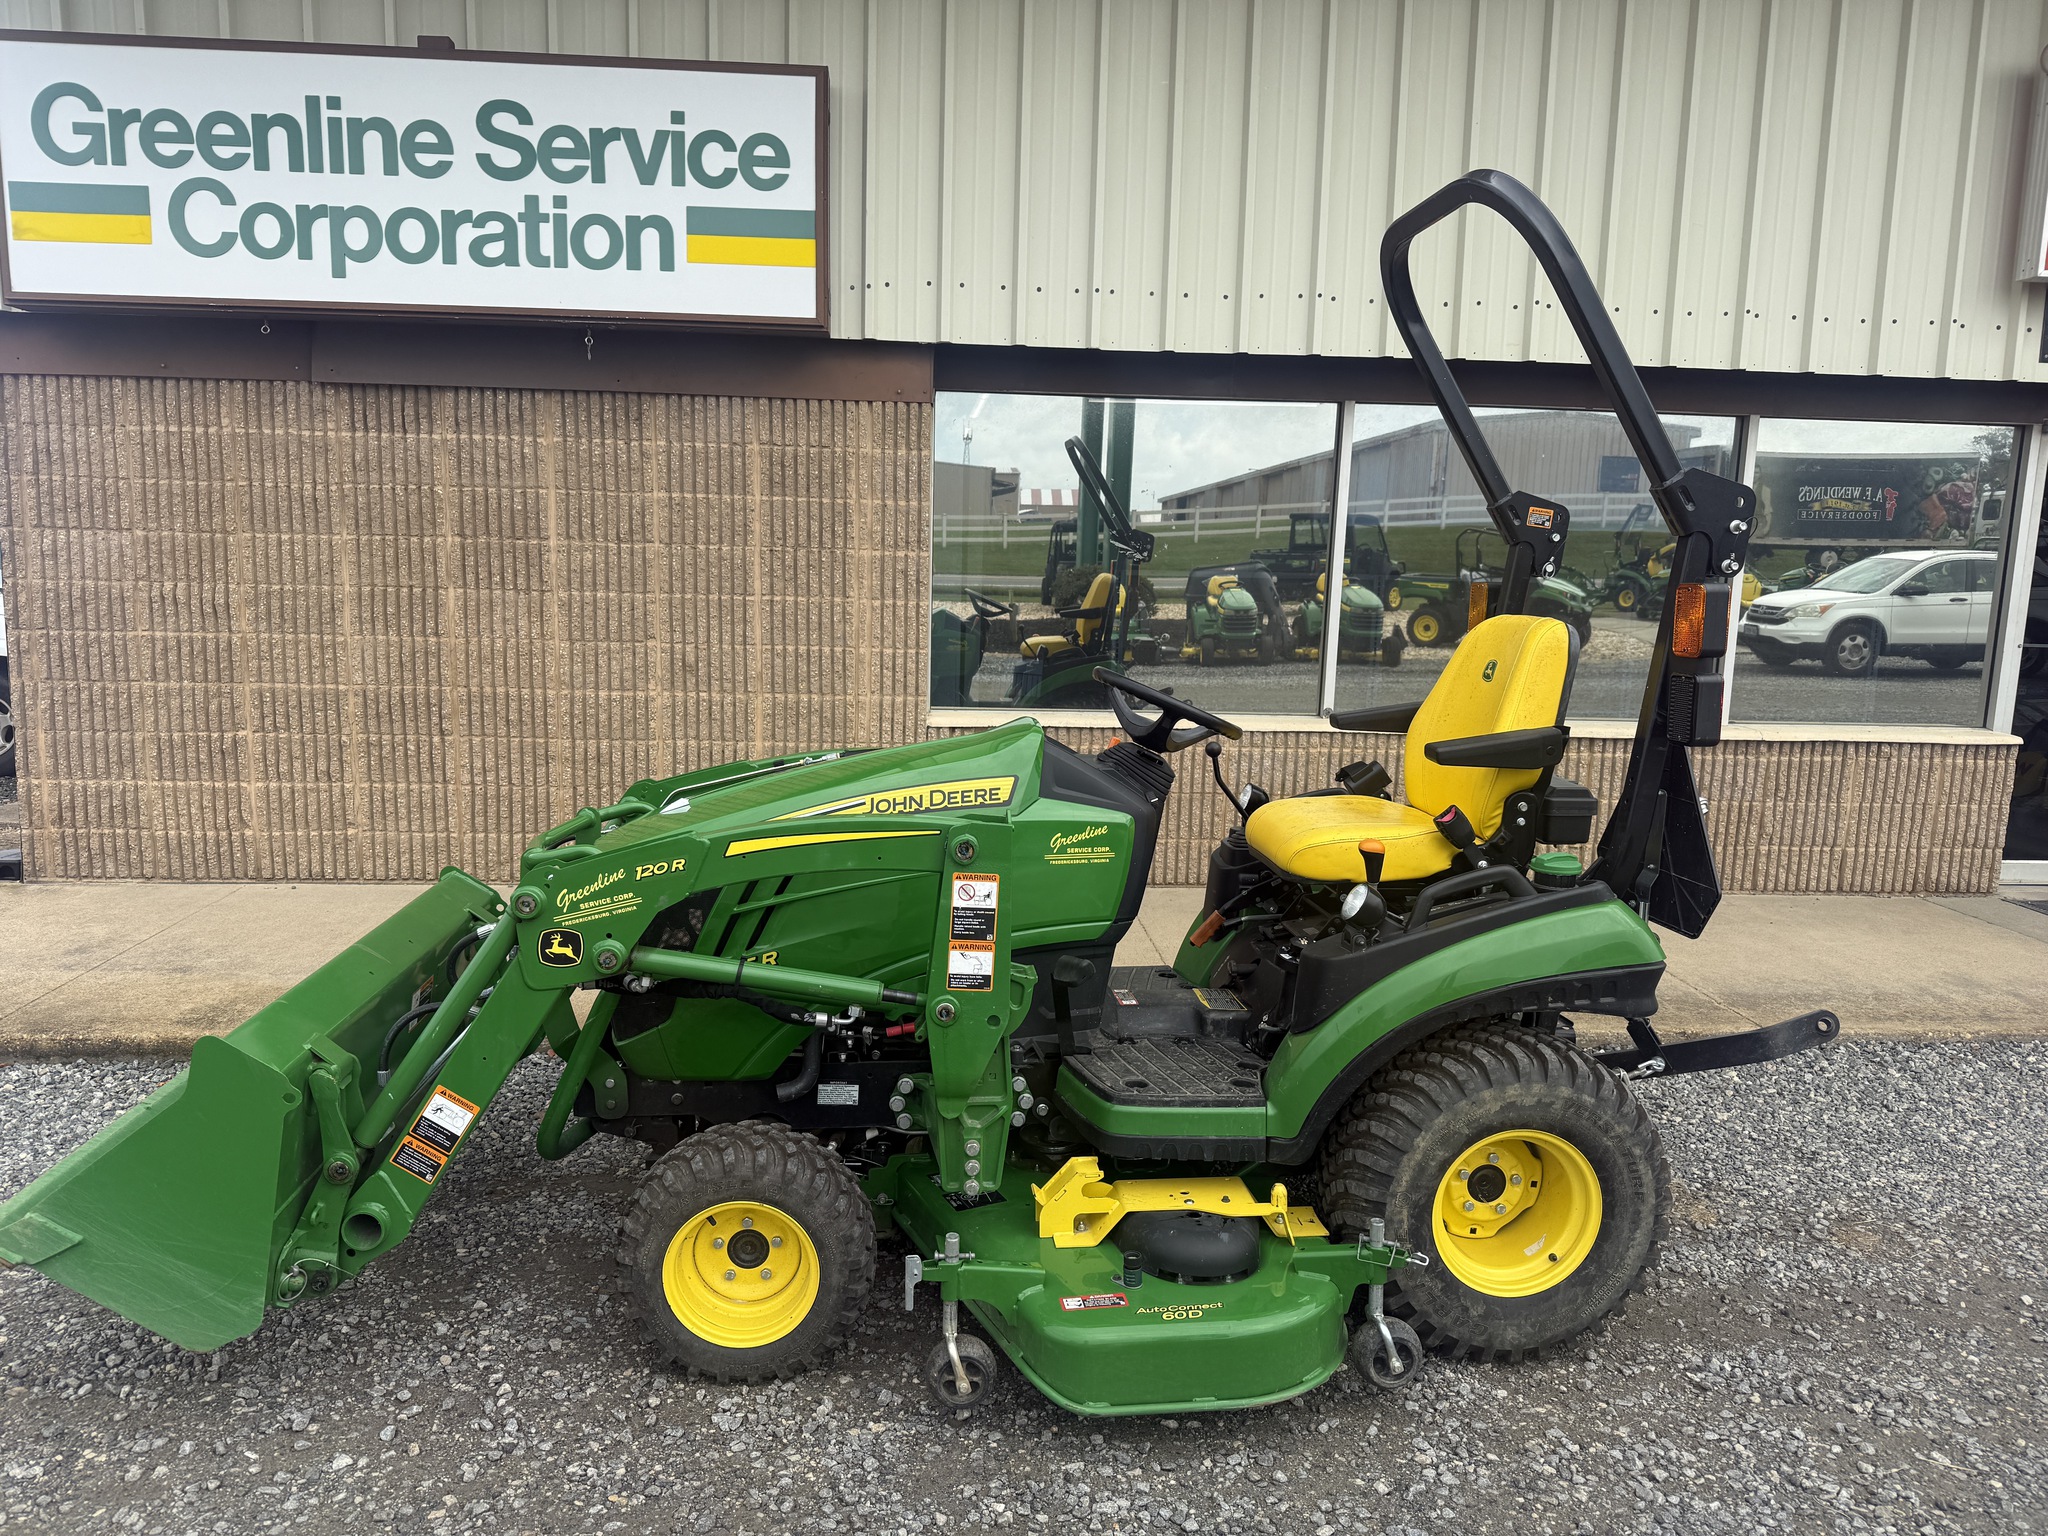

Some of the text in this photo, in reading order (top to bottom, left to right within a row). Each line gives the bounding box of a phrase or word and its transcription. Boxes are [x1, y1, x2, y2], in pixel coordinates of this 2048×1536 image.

[30, 81, 791, 191] Greenline Service
[166, 177, 675, 278] Corporation
[868, 787, 1002, 815] JOHN DEERE
[1050, 825, 1109, 853] Greenline
[556, 868, 627, 913] Greenline
[579, 892, 636, 910] SERVICE CORP.
[447, 1092, 475, 1112] WARNING
[415, 1142, 442, 1162] WARNING
[1136, 1302, 1223, 1314] AutoConnect
